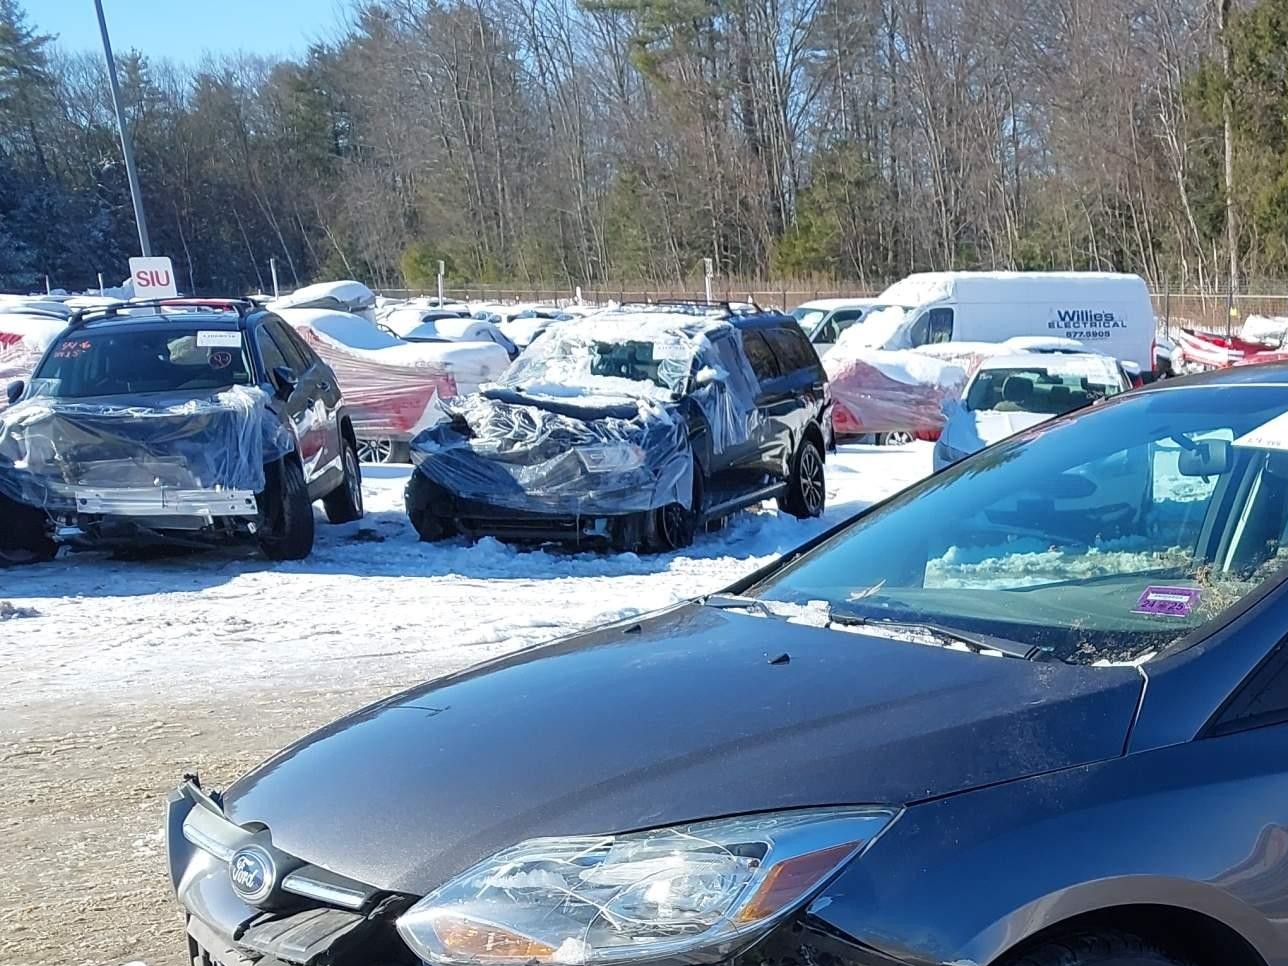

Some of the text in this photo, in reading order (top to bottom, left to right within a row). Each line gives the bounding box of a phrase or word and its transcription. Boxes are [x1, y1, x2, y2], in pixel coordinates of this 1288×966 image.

[136, 270, 170, 287] SIU
[1057, 309, 1115, 322] Willie's
[1047, 320, 1127, 329] ELECTRICAL
[232, 855, 259, 888] Ford
